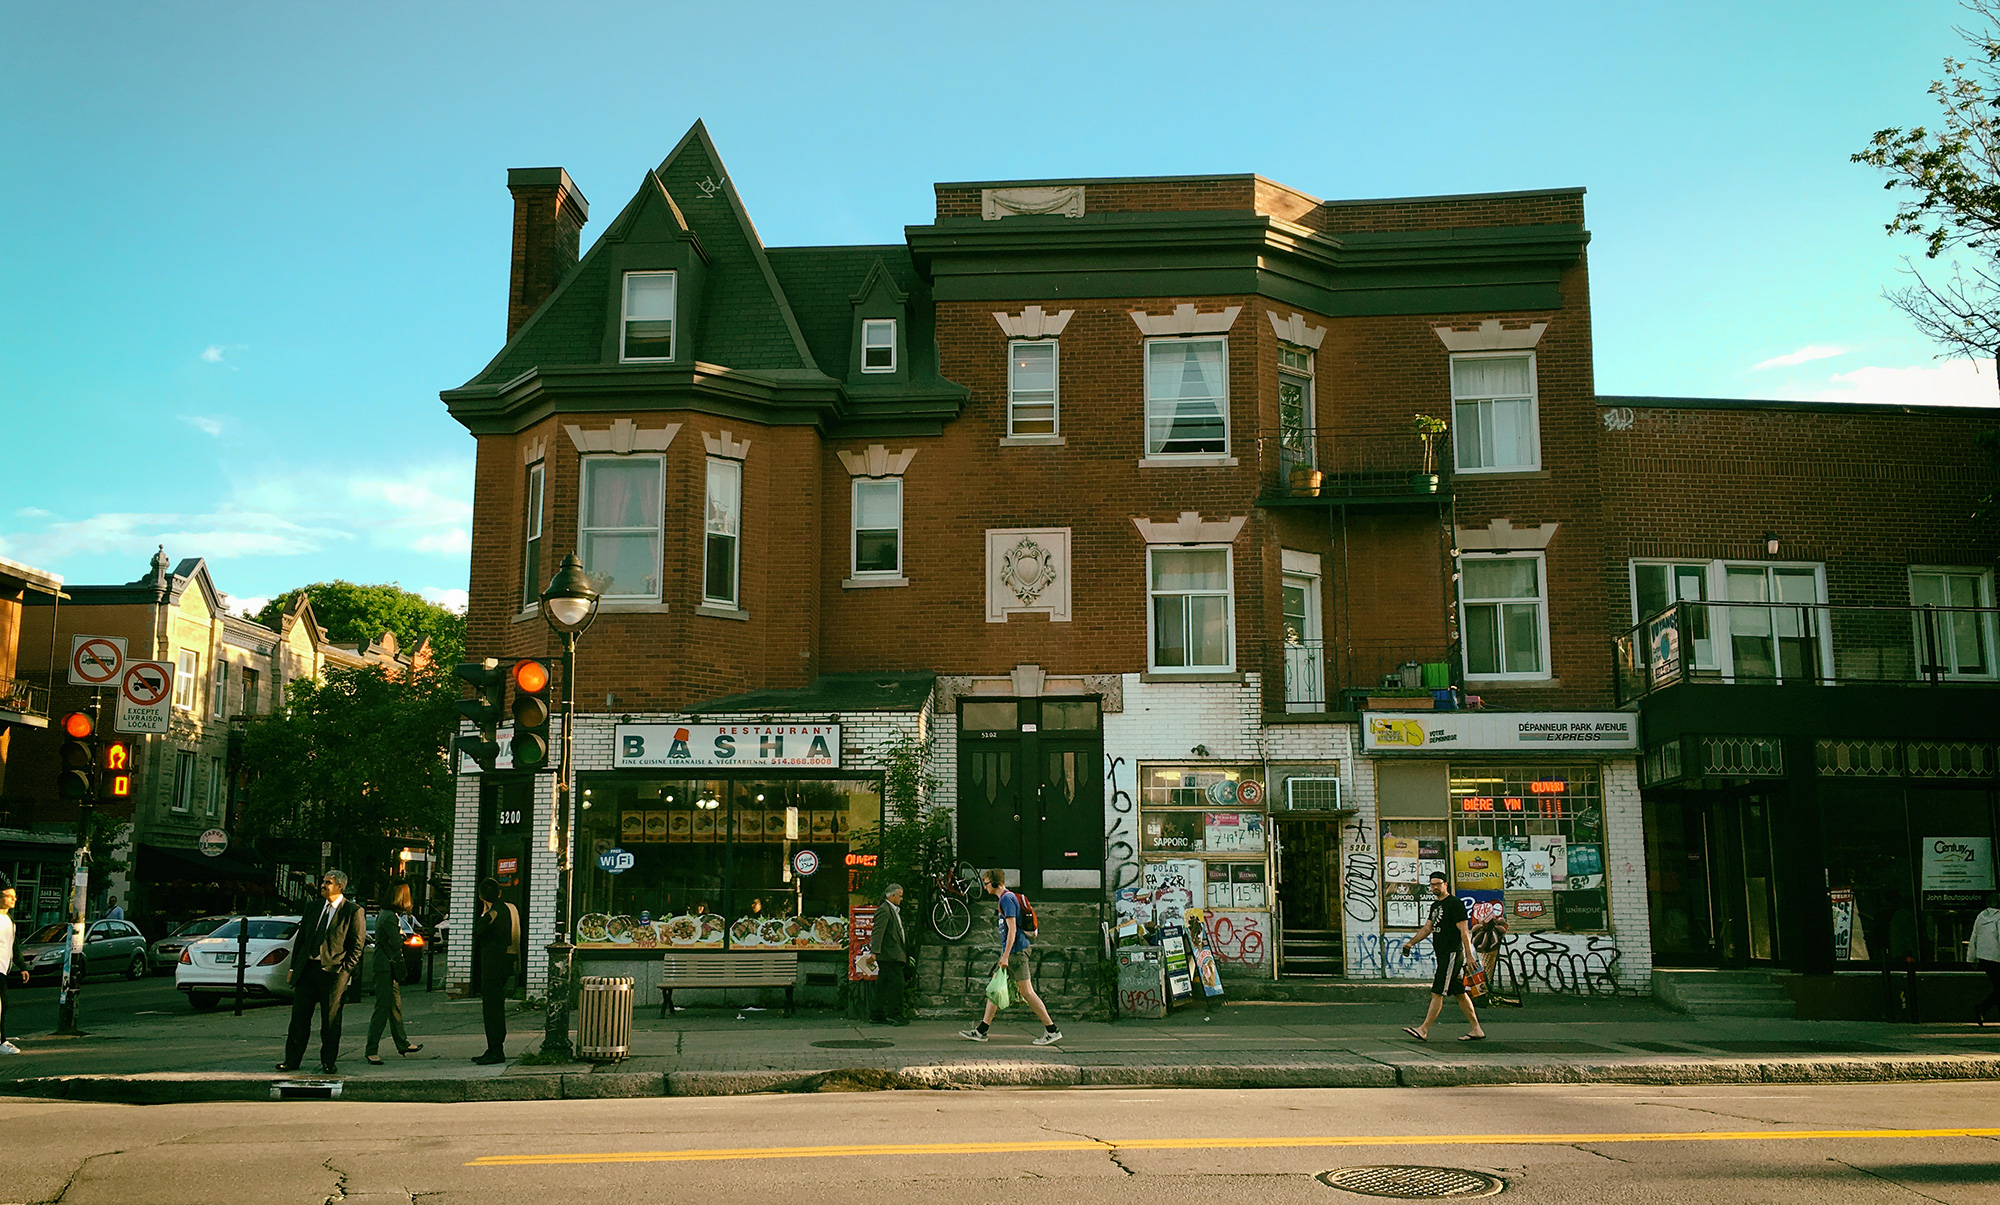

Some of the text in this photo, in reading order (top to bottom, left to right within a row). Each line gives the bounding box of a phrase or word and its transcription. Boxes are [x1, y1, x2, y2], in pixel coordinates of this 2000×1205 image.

[123, 714, 163, 722] LIVRAISON
[719, 727, 832, 735] RESTAURANT
[1518, 722, 1627, 732] DÉPANNEUR PARK AVENUE
[1546, 733, 1600, 741] EXPRESS
[623, 735, 831, 758] BASHA
[1463, 797, 1521, 811] BIÈRE VIN
[500, 810, 521, 824] 5200
[1153, 837, 1188, 847] SAPPORO
[1934, 840, 1974, 862] Century 21
